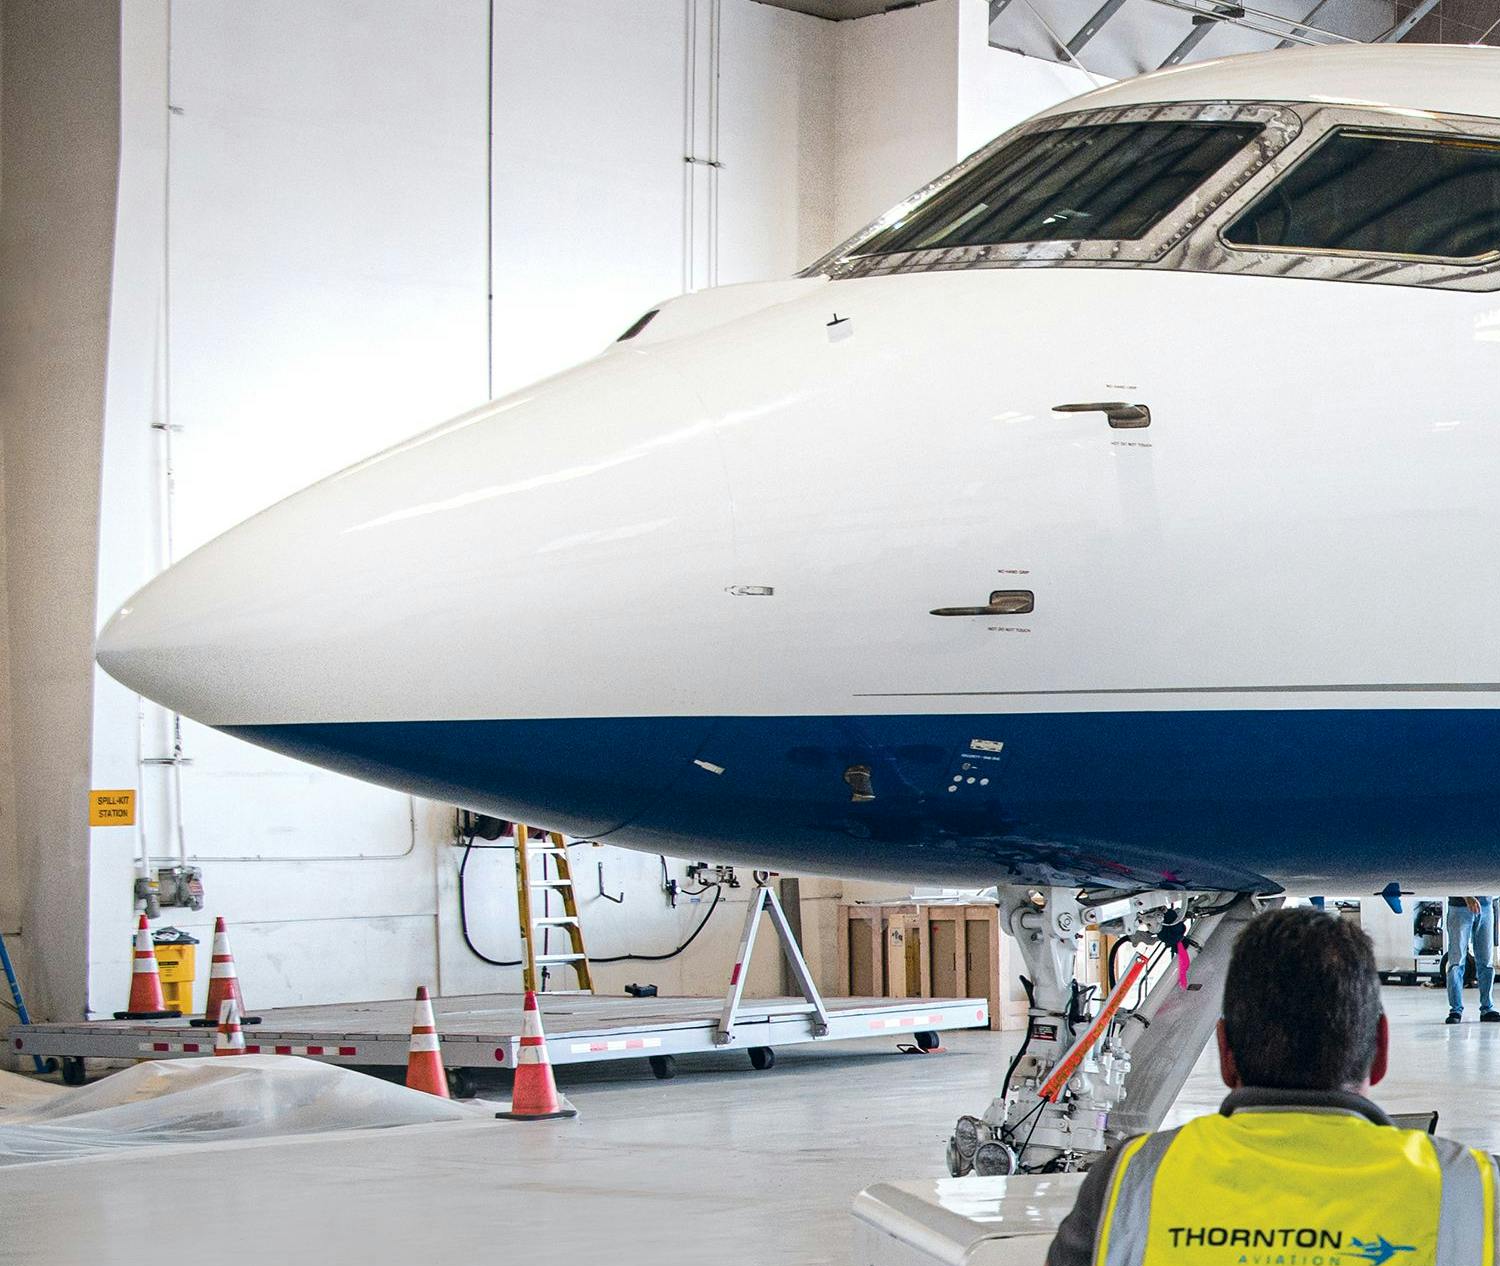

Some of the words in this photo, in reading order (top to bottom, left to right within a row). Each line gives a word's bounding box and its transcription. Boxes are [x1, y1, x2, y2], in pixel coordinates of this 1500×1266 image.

[98, 809, 129, 818] STATION
[1168, 1227, 1342, 1249] THORNTON
[1238, 1254, 1341, 1266] AVIATION
